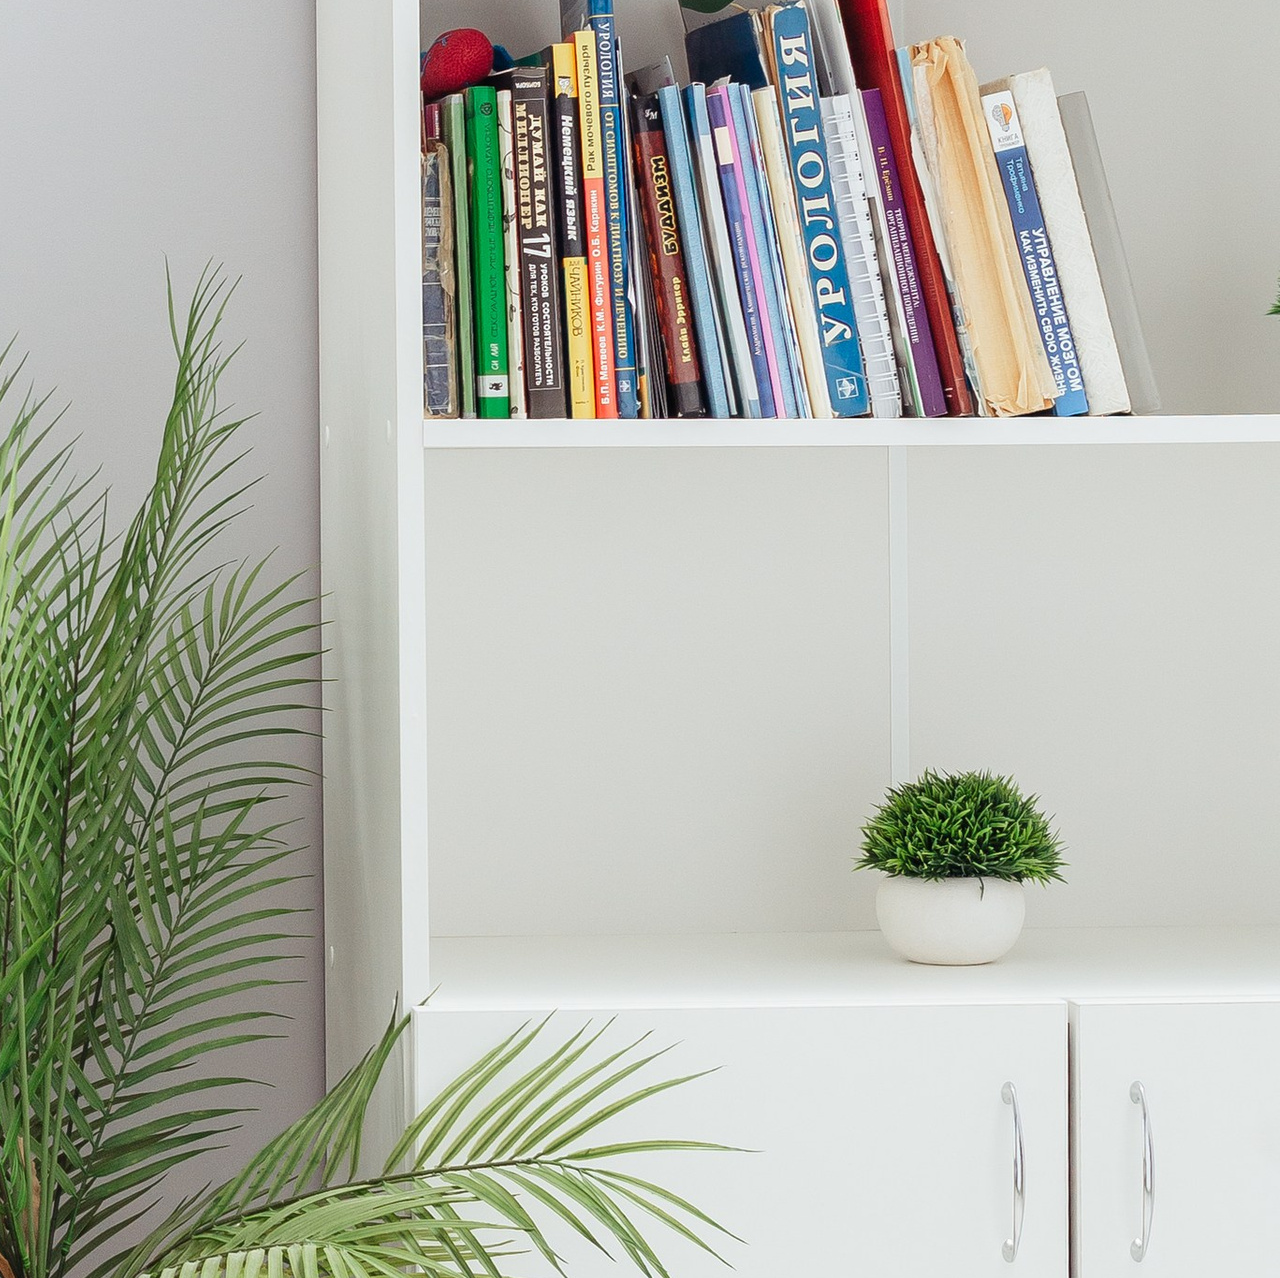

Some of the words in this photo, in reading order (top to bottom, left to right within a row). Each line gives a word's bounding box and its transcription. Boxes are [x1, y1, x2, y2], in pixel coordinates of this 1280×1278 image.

[582, 44, 593, 88] пузыря
[598, 22, 614, 99] УРОЛОГИЯ
[584, 94, 594, 148] мочевого
[604, 111, 615, 129] ОТ
[515, 103, 533, 231] МИЛЛИОНЕР
[528, 114, 547, 183] ДУМАЙ
[561, 115, 578, 196] Немецкий
[586, 159, 596, 172] Рак
[605, 130, 619, 210] СИМПТОМОВ
[779, 32, 852, 347] УРОЛОГИЯ
[882, 170, 894, 202] Ерёмин
[1007, 159, 1025, 214] Трофименко
[1015, 157, 1028, 191] Татьяна
[534, 187, 547, 228] КАК
[566, 199, 578, 241] язык
[590, 189, 601, 233] Карякин
[609, 212, 619, 221] К
[651, 155, 679, 256] БУДДИЗМ
[523, 232, 552, 258] 17
[591, 234, 601, 257] О.Б.
[609, 222, 624, 286] ДИАГНОЗУ
[894, 208, 907, 242] ТЕОРИЯ
[901, 242, 920, 309] МЕНЕДЖМЕНТА:
[1020, 230, 1033, 254] КАК
[528, 263, 537, 279] ДЛЯ
[539, 263, 550, 298] УРОКОВ
[594, 261, 605, 306] Фигурин
[614, 288, 624, 298] И
[886, 209, 908, 294] ОРГАНИЗАЦИОННОЕ
[903, 294, 920, 344] ПОВЕДЕНИЕ
[1025, 254, 1048, 316] ИЗМЕНИТЬ
[531, 297, 539, 312] КТО
[569, 267, 584, 337] ЧАЙНИКОВ
[595, 308, 606, 332] К.М.
[672, 276, 686, 325] Эррикер
[1032, 227, 1067, 325] УПРАВЛЕНИЕ
[1057, 327, 1083, 392] МОЗГОМ
[532, 313, 540, 336] ГОТОВ
[542, 301, 554, 386] СОСТОЯТЕЛЬНОСТИ
[615, 300, 628, 359] ЛЕЧЕНИЮ
[678, 327, 692, 363] Клайв
[1041, 317, 1057, 353] СВОЮ
[533, 337, 543, 386] РАЗБОГАТЕТЬ
[598, 336, 610, 381] Матвеев
[1050, 355, 1067, 397] ЖИЗНЬ
[600, 381, 610, 405] Б.П.
